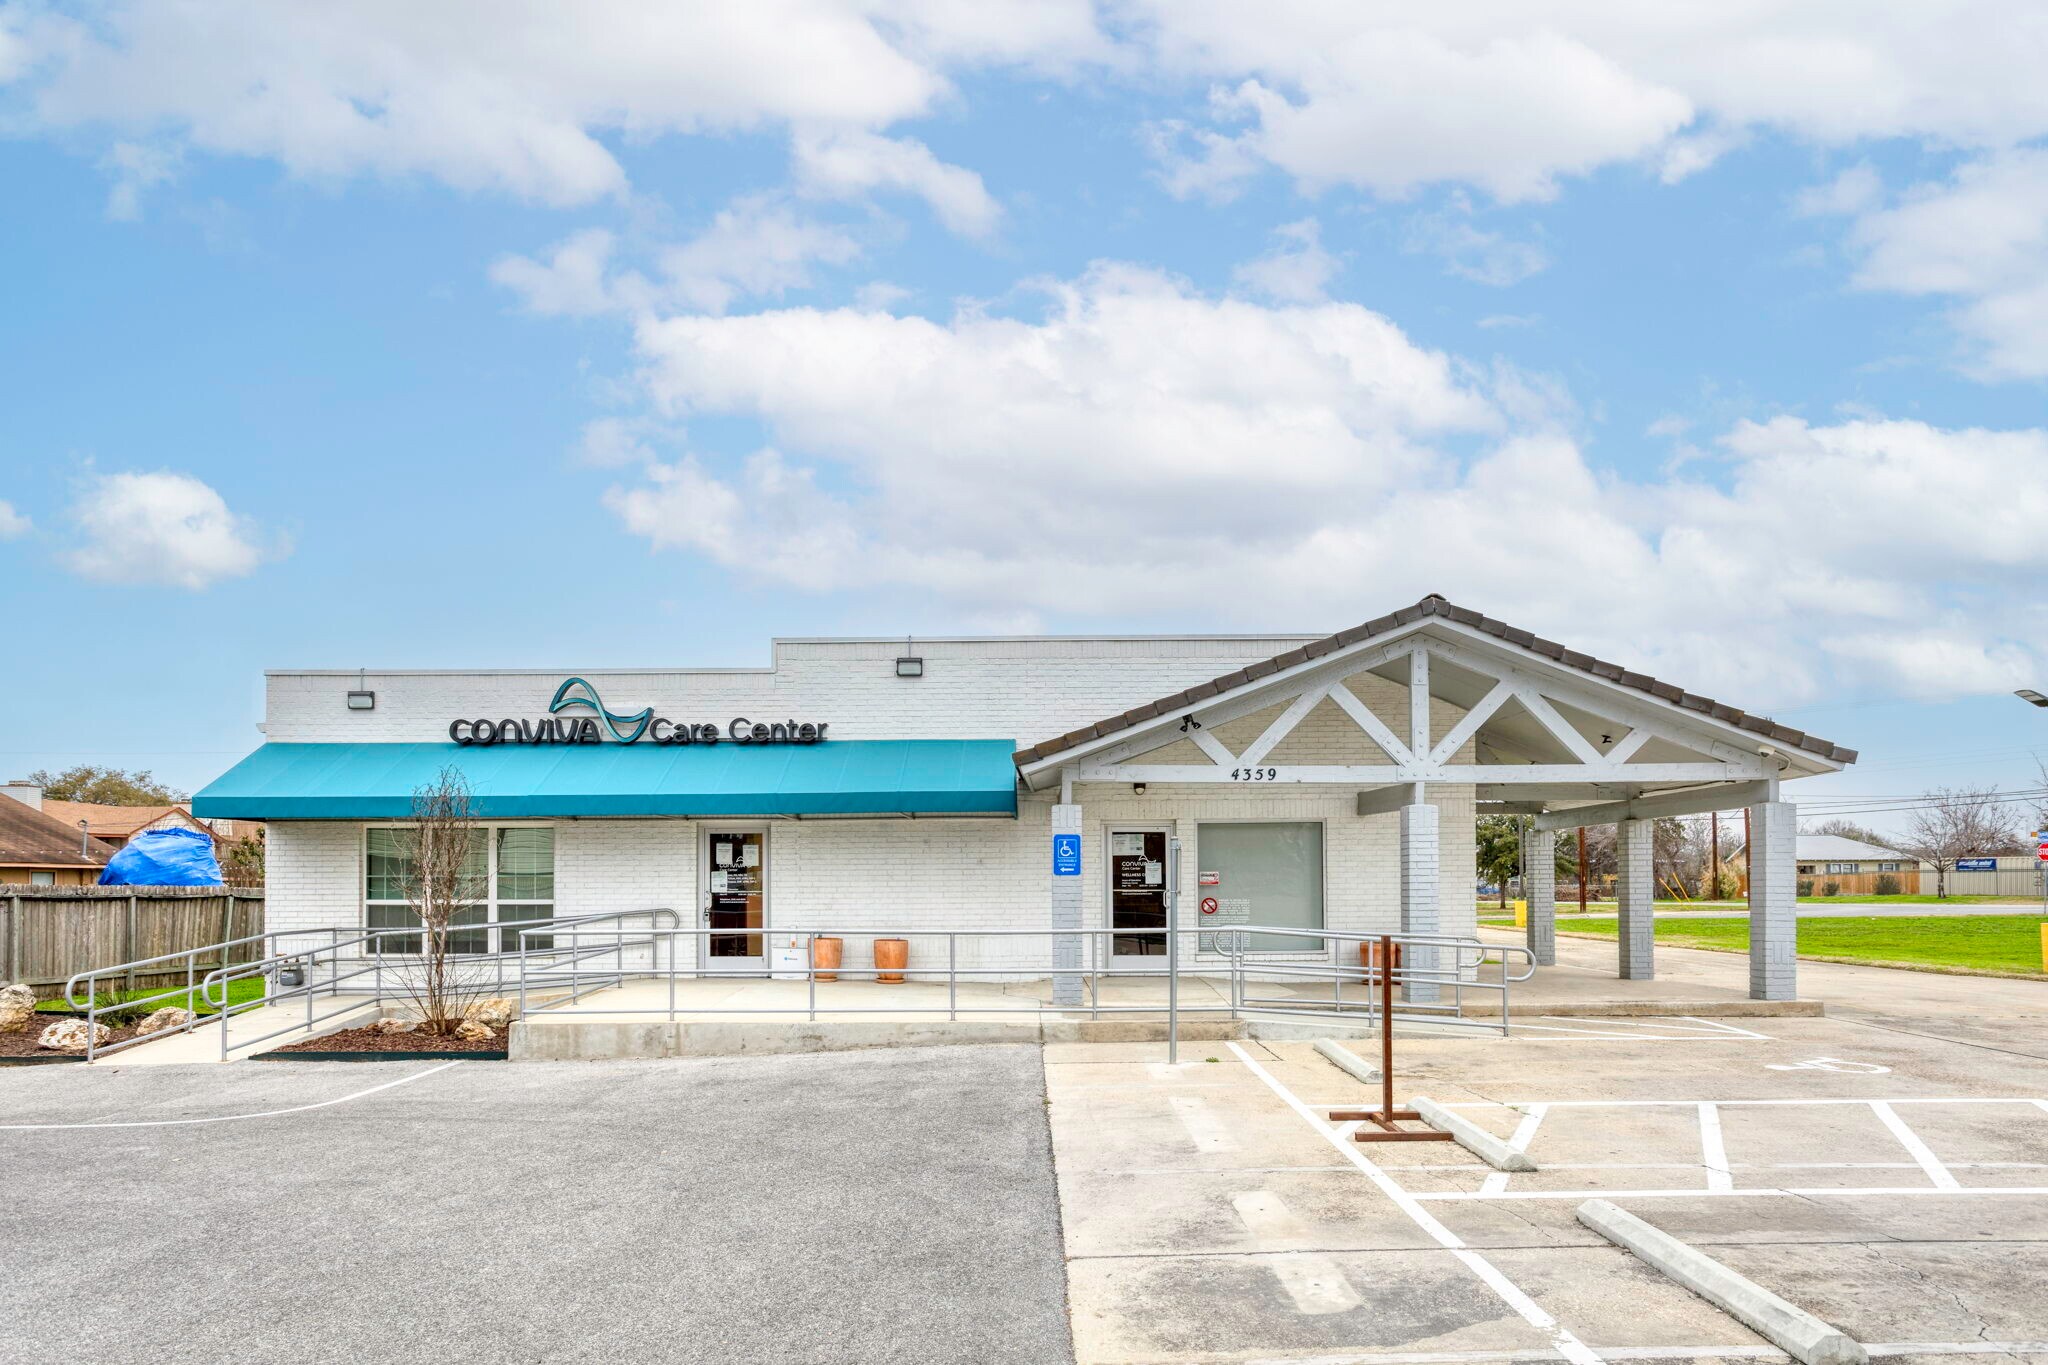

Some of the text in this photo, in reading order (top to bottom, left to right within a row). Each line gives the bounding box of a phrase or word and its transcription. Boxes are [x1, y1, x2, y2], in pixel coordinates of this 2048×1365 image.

[649, 717, 720, 743] Care
[728, 717, 828, 743] Center
[1231, 767, 1277, 781] 4359
